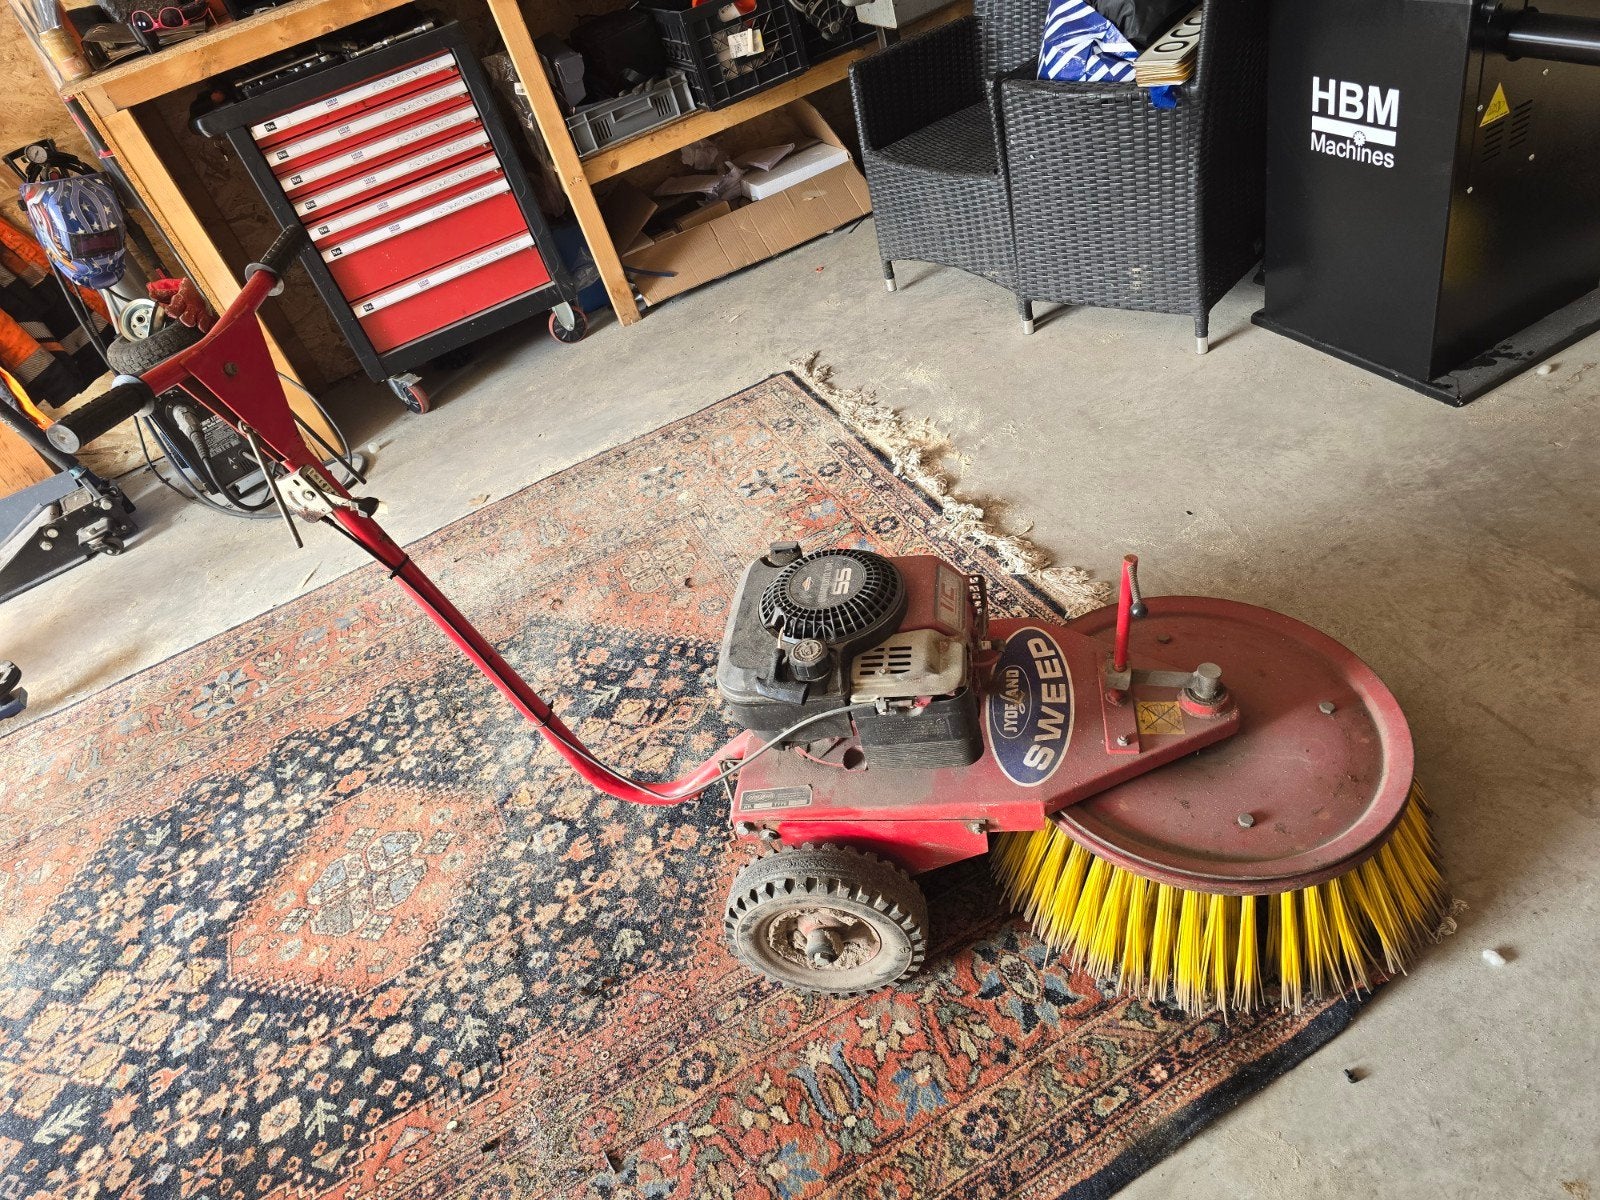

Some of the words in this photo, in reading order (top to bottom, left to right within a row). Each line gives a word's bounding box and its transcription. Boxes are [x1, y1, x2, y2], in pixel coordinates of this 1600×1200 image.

[1311, 76, 1400, 127] HBM
[1310, 132, 1395, 168] Machines
[1023, 637, 1067, 770] SWEEP
